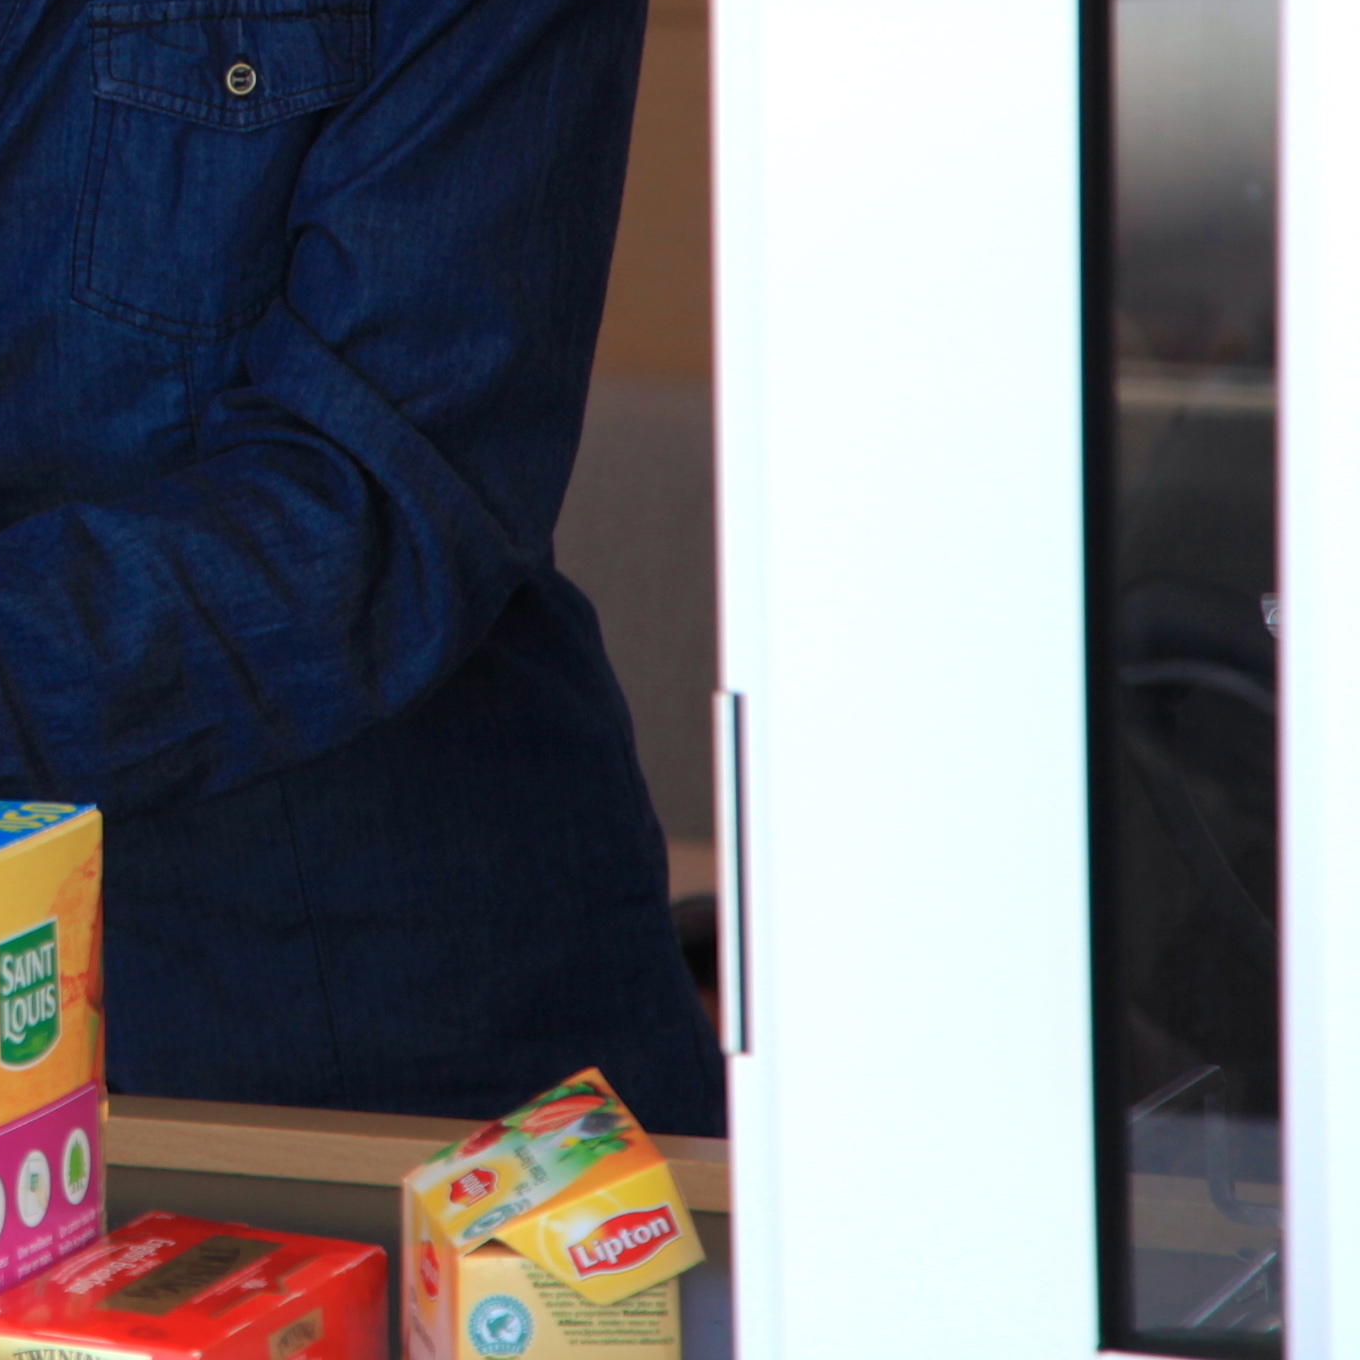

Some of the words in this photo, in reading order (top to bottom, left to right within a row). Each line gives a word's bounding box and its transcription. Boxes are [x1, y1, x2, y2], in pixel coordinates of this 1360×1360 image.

[1, 942, 55, 997] SAINT
[2, 985, 56, 1045] LOUIS
[460, 1172, 490, 1205] Lipton
[577, 1216, 671, 1268] Lipton
